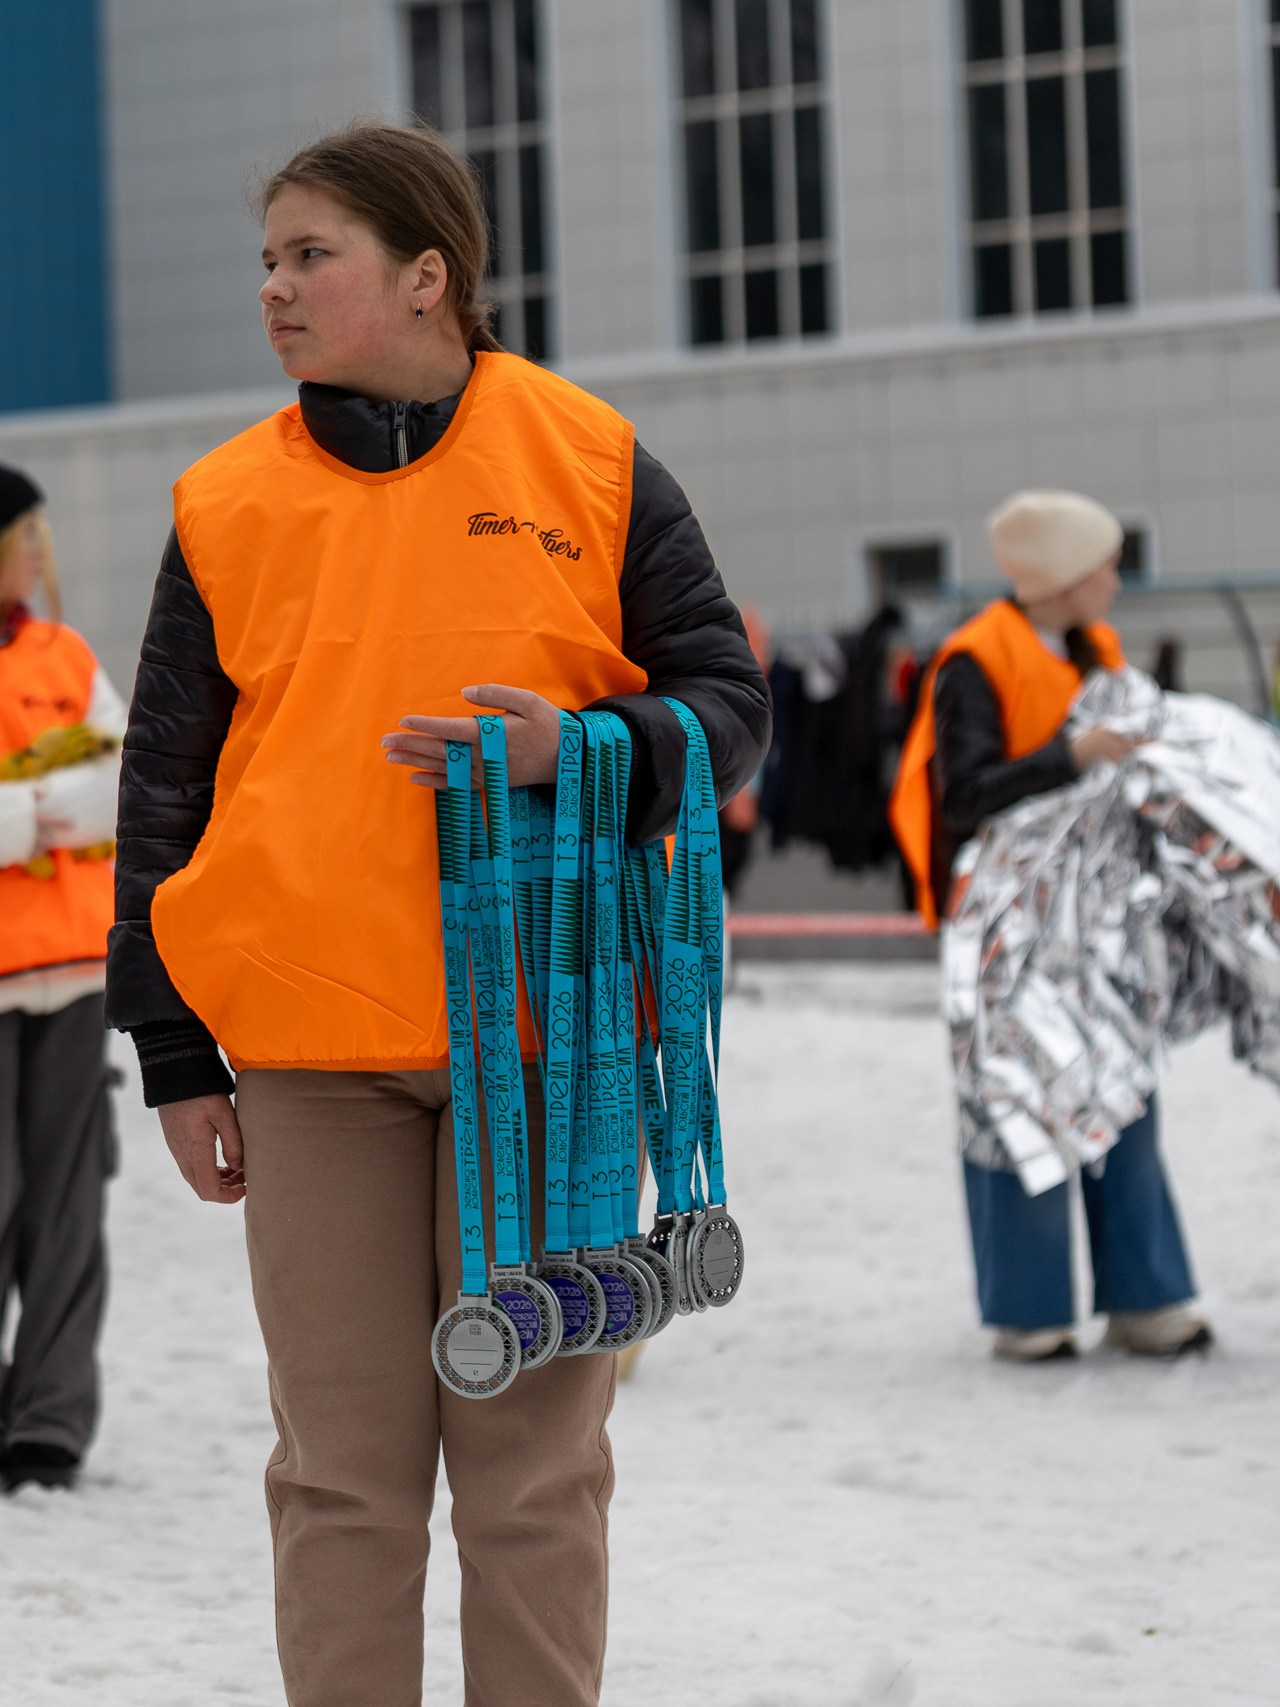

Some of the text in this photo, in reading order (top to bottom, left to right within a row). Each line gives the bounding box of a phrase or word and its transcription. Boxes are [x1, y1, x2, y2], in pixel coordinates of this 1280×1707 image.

[665, 957, 685, 1015] 2026
[681, 962, 700, 1019] 2026
[551, 992, 571, 1050] 2026
[506, 1300, 531, 1310] 2026
